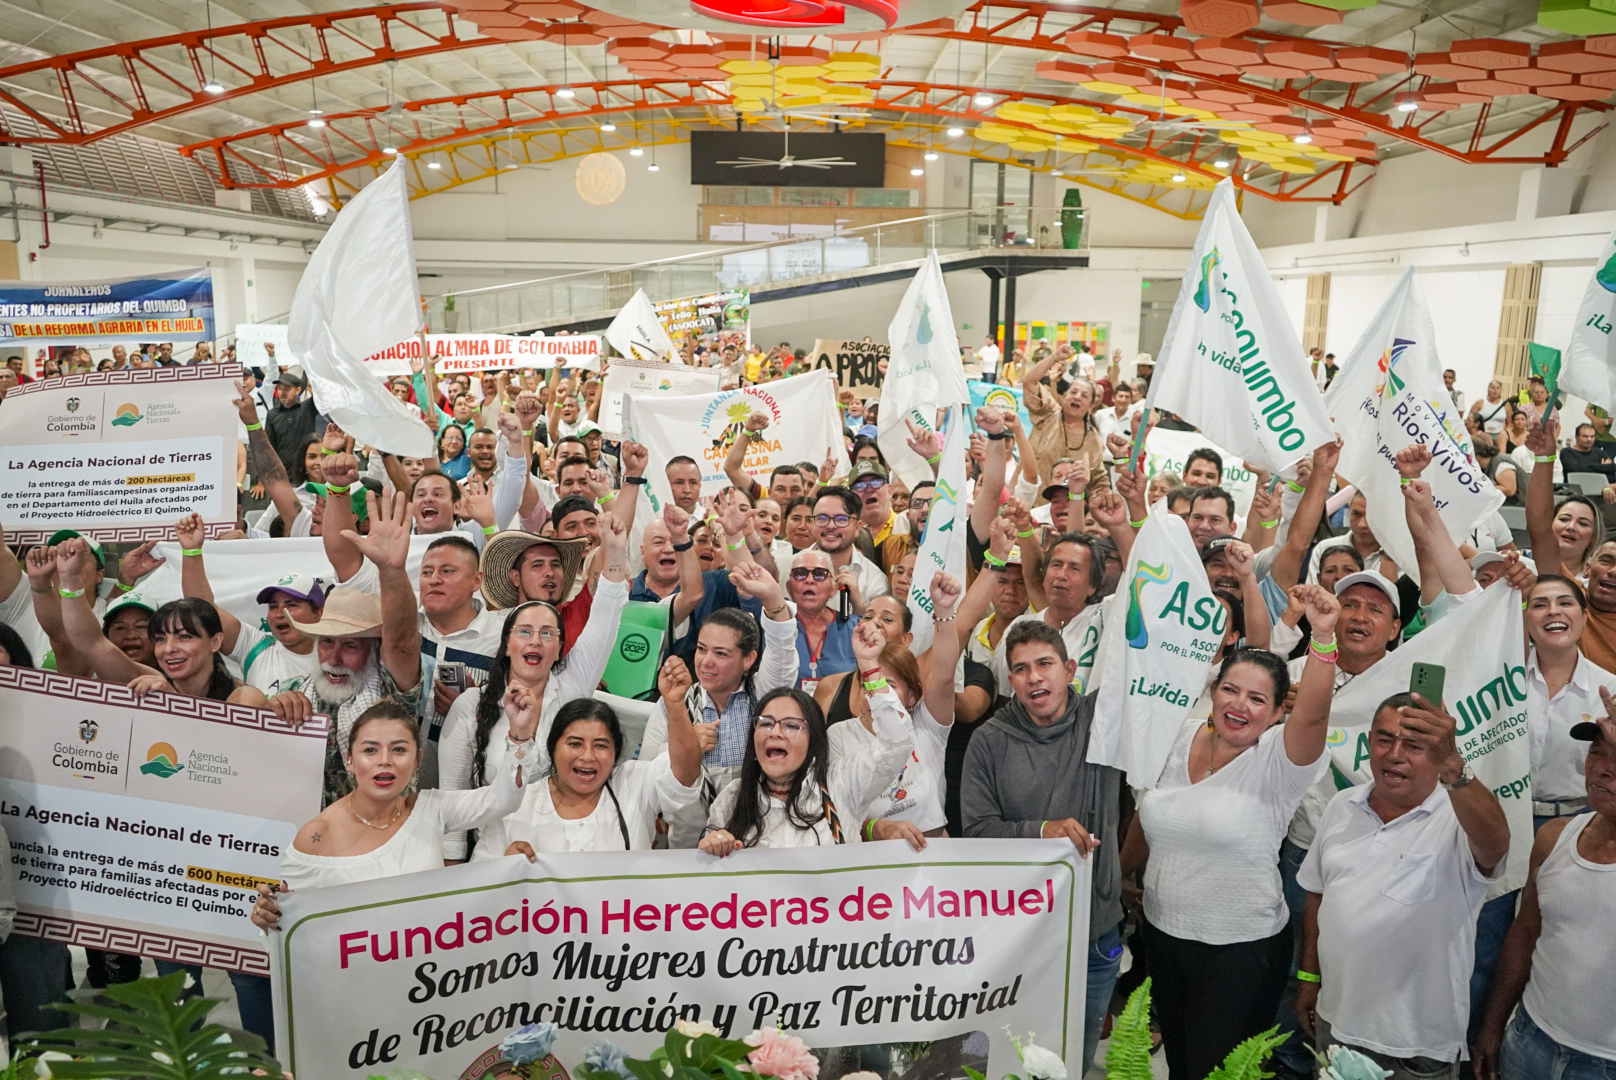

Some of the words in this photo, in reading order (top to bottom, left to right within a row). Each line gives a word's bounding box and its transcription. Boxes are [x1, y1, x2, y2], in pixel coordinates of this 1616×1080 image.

[30, 303, 45, 317] NO
[48, 301, 121, 317] PROPIETARIOS
[122, 300, 143, 314] DEL
[143, 299, 187, 313] QUIMBO
[670, 310, 691, 321] Tello
[698, 306, 722, 316] Huila
[14, 324, 28, 337] DE
[30, 323, 43, 337] LA
[44, 322, 96, 336] REFORMA
[99, 320, 144, 335] AGRARIA
[146, 320, 159, 333] EN
[161, 319, 173, 332] EL
[175, 317, 205, 332] HUILA
[494, 339, 513, 355] DE
[518, 338, 598, 355] COLOMBIA
[444, 357, 517, 370] PRESENTE
[146, 402, 175, 411] Agencia
[146, 409, 177, 417] Nacional
[701, 388, 741, 430] JUNTANZA
[743, 387, 782, 422] NACIONAL
[46, 422, 96, 432] Colombia
[47, 414, 84, 423] Gobierno
[85, 414, 96, 422] de
[145, 417, 170, 425] Tierras
[1392, 401, 1430, 445] Ríos
[1431, 439, 1484, 494] Vivos
[8, 460, 24, 470] La
[27, 457, 83, 471] Agencia
[87, 455, 145, 467] Nacional
[149, 454, 165, 465] de
[169, 452, 212, 463] Tierras
[713, 462, 721, 472] Y
[39, 481, 76, 489] entrega
[92, 478, 112, 486] más
[128, 477, 145, 485] 200
[147, 474, 191, 483] hectáreas
[1, 491, 13, 499] de
[44, 491, 65, 499] para
[160, 483, 215, 494] organizadas
[32, 500, 101, 509] Departamento
[103, 498, 118, 506] del
[120, 497, 144, 505] Huila
[145, 495, 190, 504] afectadas
[192, 494, 208, 503] por
[20, 511, 29, 519] el
[31, 511, 74, 520] Proyecto
[76, 507, 142, 517] Hidroeléctrico
[144, 507, 153, 515] El
[154, 505, 194, 515] Quimbo.
[911, 584, 935, 615] vida
[1160, 641, 1179, 655] POR
[1181, 649, 1188, 658] EL
[1152, 682, 1190, 708] vida
[1517, 726, 1527, 737] EL
[53, 742, 103, 759] Gobierno
[105, 750, 120, 761] de
[1464, 737, 1479, 751] DE
[52, 754, 118, 775] Colombia
[188, 749, 228, 765] Agencia
[187, 760, 232, 776] Nacional
[187, 770, 222, 785] Tierras
[0, 800, 20, 817] La
[25, 805, 100, 828] Agencia
[106, 816, 185, 841] Nacional
[189, 829, 213, 846] de
[218, 833, 280, 857] Tierras
[47, 844, 59, 856] la
[62, 849, 114, 866] entrega
[117, 856, 134, 867] de
[138, 860, 165, 873] más
[168, 864, 185, 876] de
[187, 867, 213, 881] 600
[216, 871, 280, 892] hectárs
[11, 854, 27, 866] de
[30, 857, 65, 872] tierra
[68, 865, 98, 877] para
[101, 868, 152, 886] familias
[154, 878, 219, 897] afectadas
[222, 889, 246, 902] por
[248, 893, 260, 904] e
[19, 870, 77, 889] Proyecto
[80, 880, 173, 905] Hidroeléctrico
[175, 896, 188, 908] El
[191, 899, 248, 918] Quimbo.
[339, 898, 588, 969] Fundación
[601, 892, 830, 935] Herederas
[838, 886, 893, 922] de
[902, 878, 1055, 920] Manuel
[408, 951, 539, 1003] Somos
[552, 940, 706, 992] Mujeres
[717, 932, 976, 979] Constructoras
[348, 1028, 401, 1070] de
[412, 991, 700, 1056] Reconciliación
[712, 1004, 738, 1040] y
[748, 991, 822, 1031] Paz
[832, 974, 1023, 1027] Territorial
